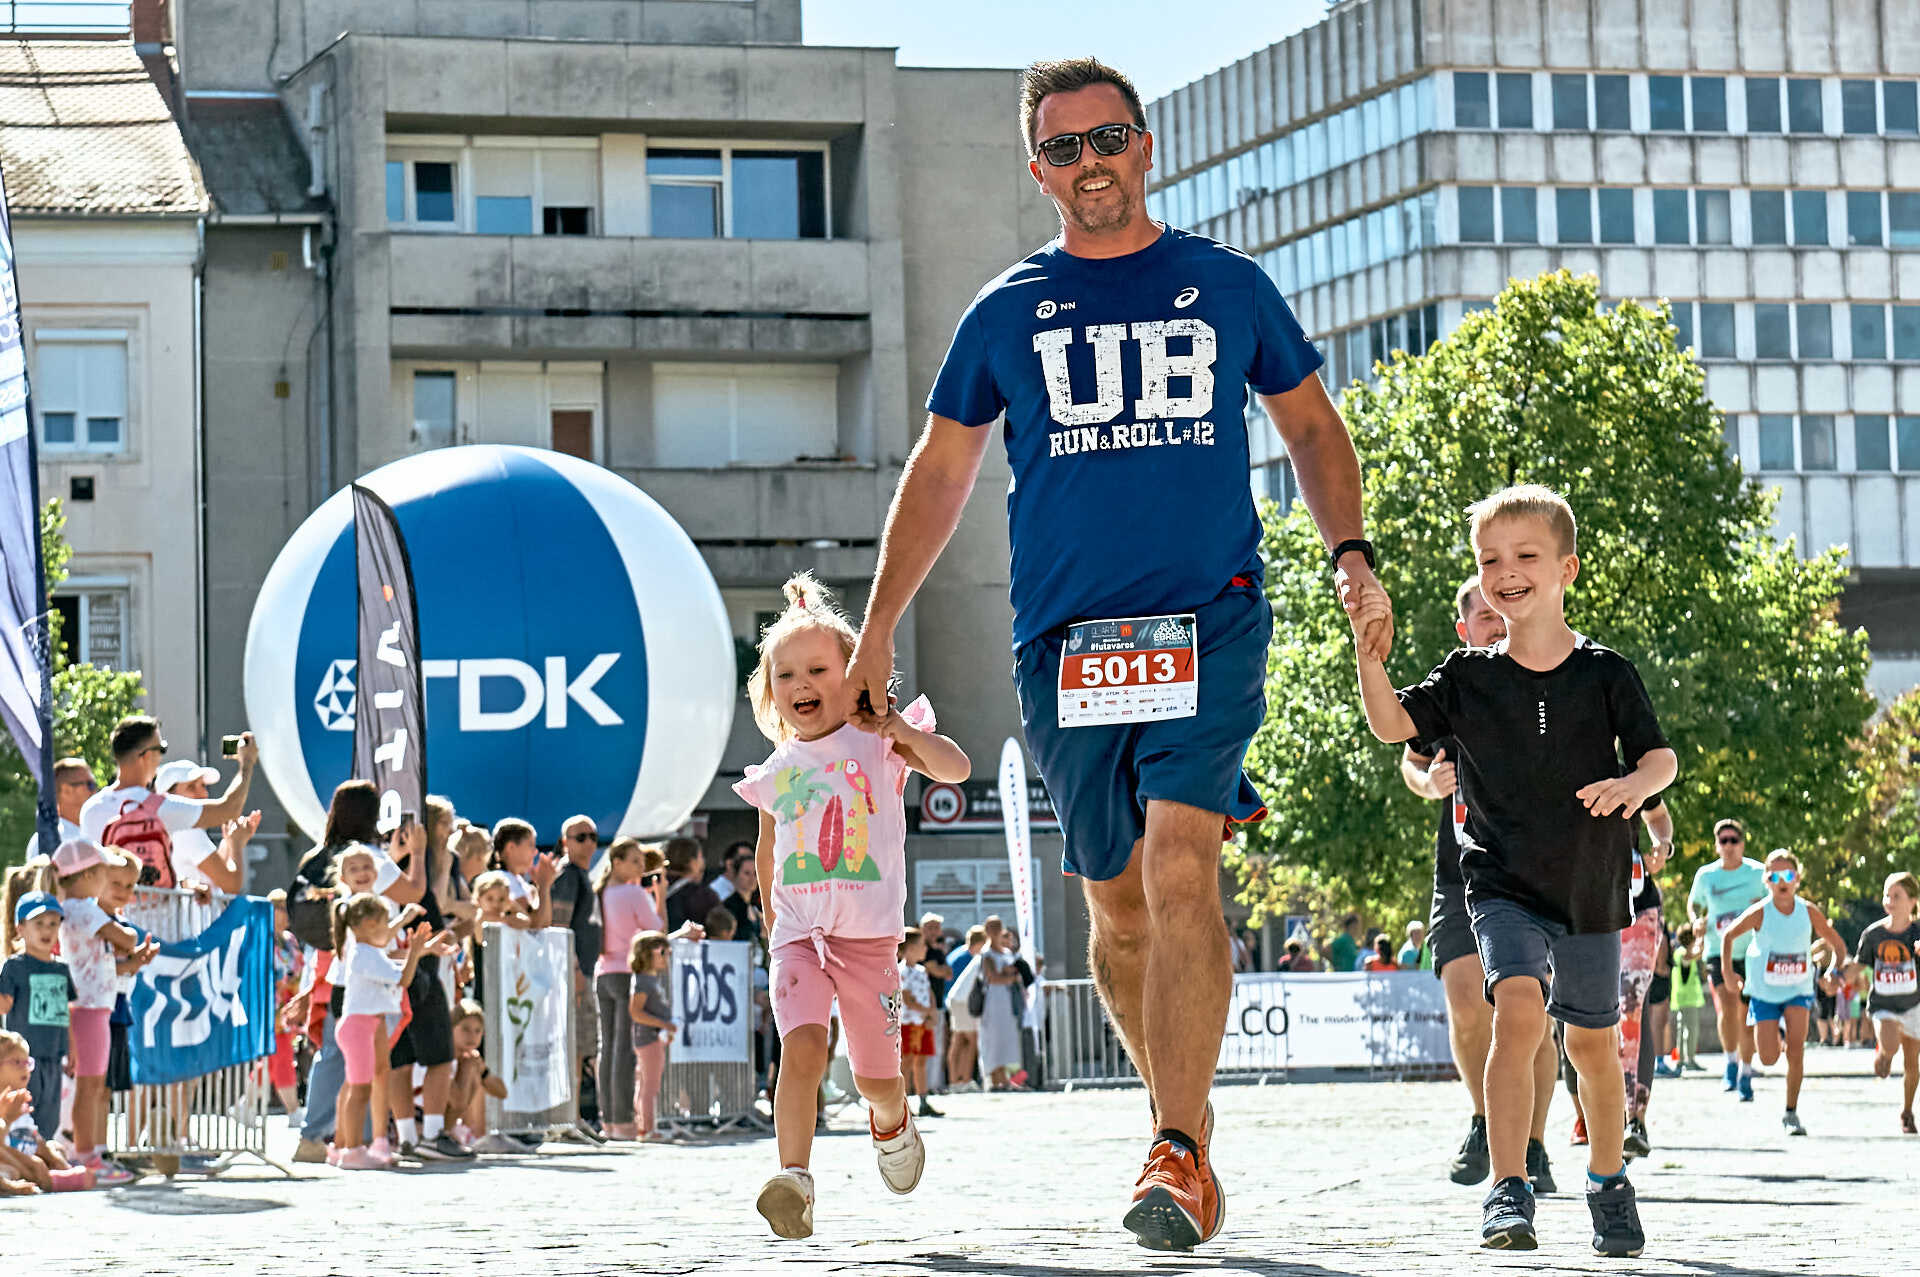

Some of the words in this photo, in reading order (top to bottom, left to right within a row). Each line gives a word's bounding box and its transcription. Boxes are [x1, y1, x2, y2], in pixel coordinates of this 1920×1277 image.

[1033, 319, 1217, 427] UB
[1081, 653, 1176, 687] 5013
[1538, 701, 1547, 735] KIPSTA
[682, 943, 737, 1048] pbs
